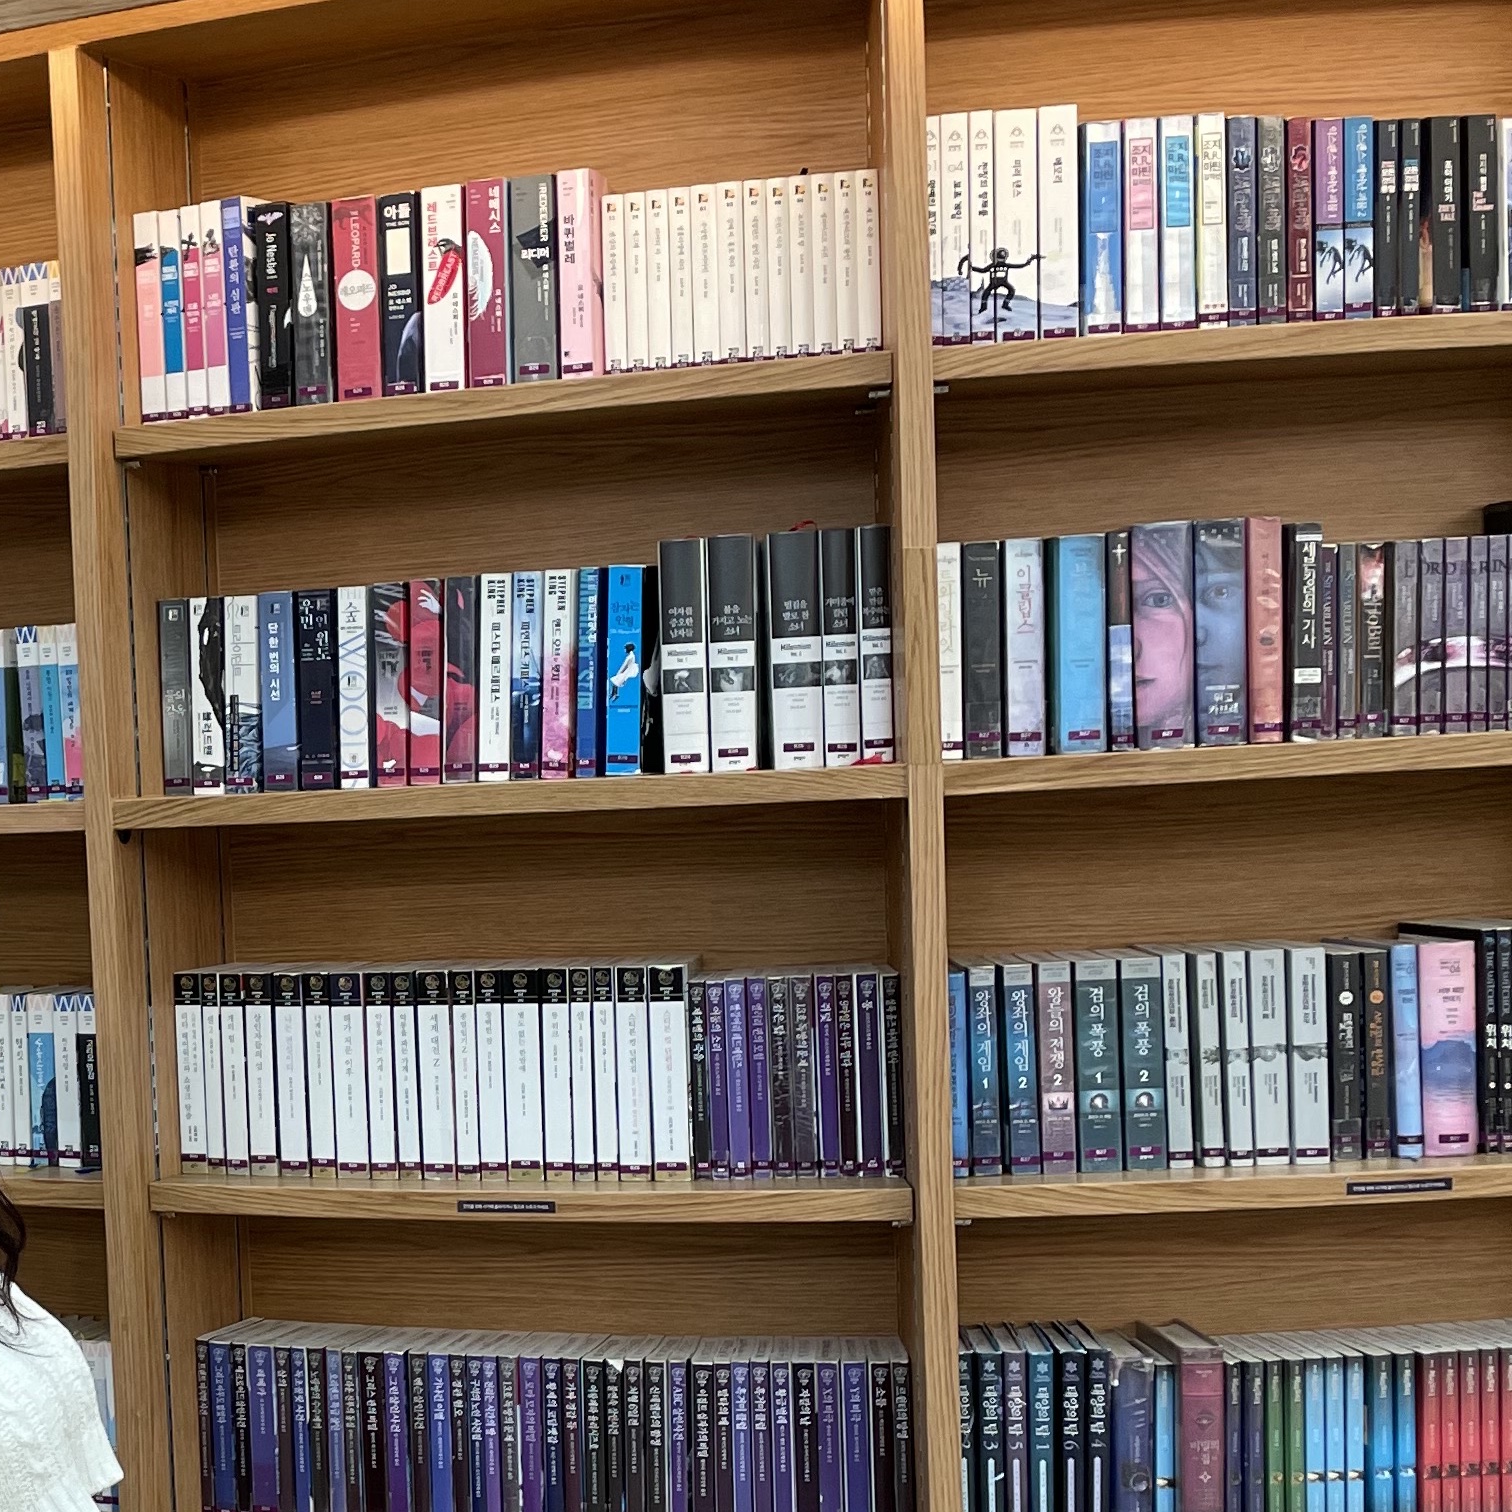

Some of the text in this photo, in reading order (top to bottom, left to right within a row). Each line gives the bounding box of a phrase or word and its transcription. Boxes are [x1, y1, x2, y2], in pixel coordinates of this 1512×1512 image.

[1092, 147, 1114, 158] 조지
[1131, 143, 1152, 156] 조지
[1052, 156, 1063, 184] 메모리
[1131, 167, 1152, 177] 마틴
[383, 202, 412, 221] 아들
[488, 185, 502, 234] 네메시스
[349, 217, 361, 268] LEOPARD
[563, 213, 576, 265] 바퀴벌레
[487, 579, 497, 599] KING
[516, 578, 525, 599] KING
[548, 575, 558, 596] KING
[972, 568, 993, 588] 뉴
[496, 579, 506, 615] STEPHEN
[525, 578, 535, 614] STEPHEN
[556, 575, 567, 611] STEPHEN
[825, 596, 855, 608] 거미줄에
[1015, 564, 1036, 635] 이클립스
[1301, 541, 1316, 650] 세븐킹덤의 기사
[341, 601, 362, 623] 숲
[611, 601, 639, 615] 잠자는
[668, 606, 693, 617] 여자를
[723, 604, 741, 615] 불을
[783, 600, 808, 610] 벌집을
[615, 615, 634, 628] 인형
[669, 616, 693, 628] 증오한
[712, 616, 735, 626] 가지고
[723, 626, 740, 637] 소녀
[788, 621, 804, 632] 소녀
[832, 618, 849, 629] 소녀
[869, 615, 884, 626] 소녀
[669, 627, 694, 639] 남자들
[267, 622, 281, 701] 단 한 번의 시선
[489, 621, 501, 703] 미스터 메르세데스
[520, 621, 530, 688] 파인더스 키퍼스
[1214, 691, 1233, 703] 위고
[1208, 703, 1238, 715] 카브레
[201, 711, 213, 756] 블러드맨
[820, 1001, 833, 1023] 쥐덫
[861, 1000, 873, 1011] 통
[709, 1005, 723, 1052] 어둠의 소리
[751, 1003, 765, 1061] 엘러리 퀸의 모험
[975, 990, 992, 1089] 왕좌의 게임 1
[1010, 989, 1029, 1089] 왕좌의 게임 2
[1047, 986, 1065, 1086] 왕들의 전쟁 2
[1088, 986, 1107, 1084] 검의 폭풍 1
[1133, 984, 1153, 1082] 검의 폭풍 2
[840, 1032, 852, 1049] 너무
[365, 1374, 379, 1431] 그리스 비밀
[672, 1386, 684, 1407] ABC
[849, 1386, 862, 1423] Y의 비극
[875, 1386, 887, 1408] 소름
[1034, 1385, 1051, 1422] 태양의
[981, 1383, 999, 1449] 태양의 탑 3
[1007, 1383, 1024, 1450] 태양의 탑 5
[1062, 1385, 1080, 1450] 태양의 탑 6
[1089, 1382, 1107, 1449] 태양의 탑 4
[1034, 1423, 1051, 1438] 탑
[696, 1442, 709, 1458] 비밀
